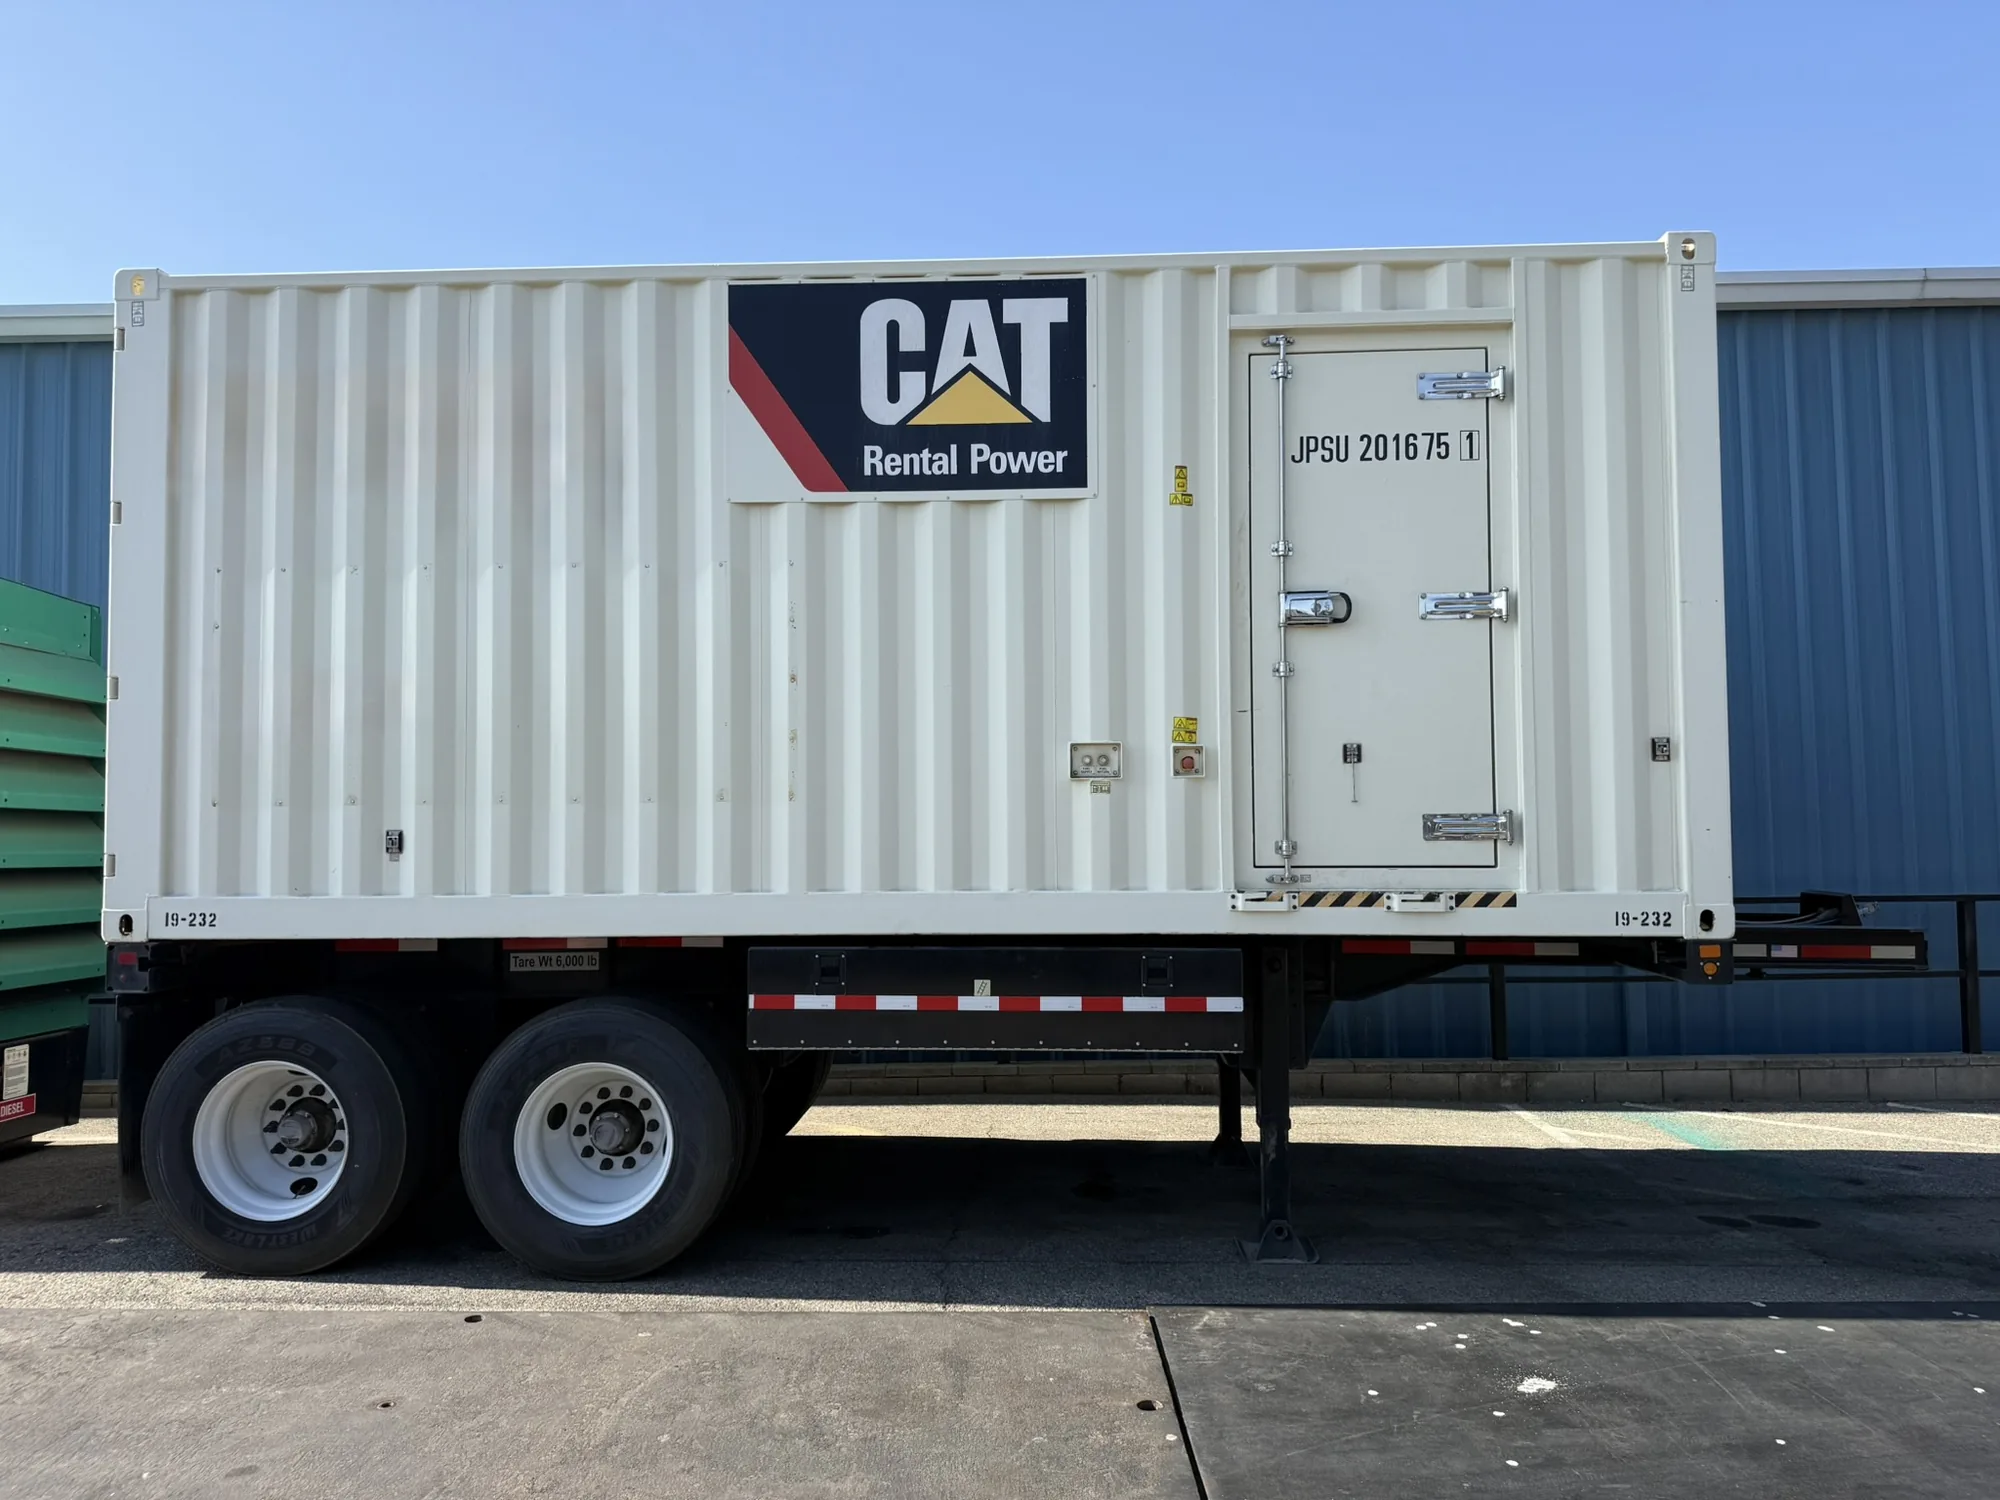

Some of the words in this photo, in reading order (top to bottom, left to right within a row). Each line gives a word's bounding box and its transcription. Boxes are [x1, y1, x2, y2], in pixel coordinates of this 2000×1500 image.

[860, 298, 1069, 425] CAT
[1291, 434, 1349, 464] JPSU
[1359, 432, 1450, 462] 201675
[863, 444, 958, 476] Rental
[970, 443, 1068, 475] Power
[165, 912, 217, 927] 19-232
[1615, 911, 1672, 927] 19-232
[512, 955, 536, 968] Tare
[538, 955, 553, 968] Wt
[556, 954, 584, 968] 6,000
[587, 954, 598, 967] lb
[0, 1101, 25, 1117] DIESEL
